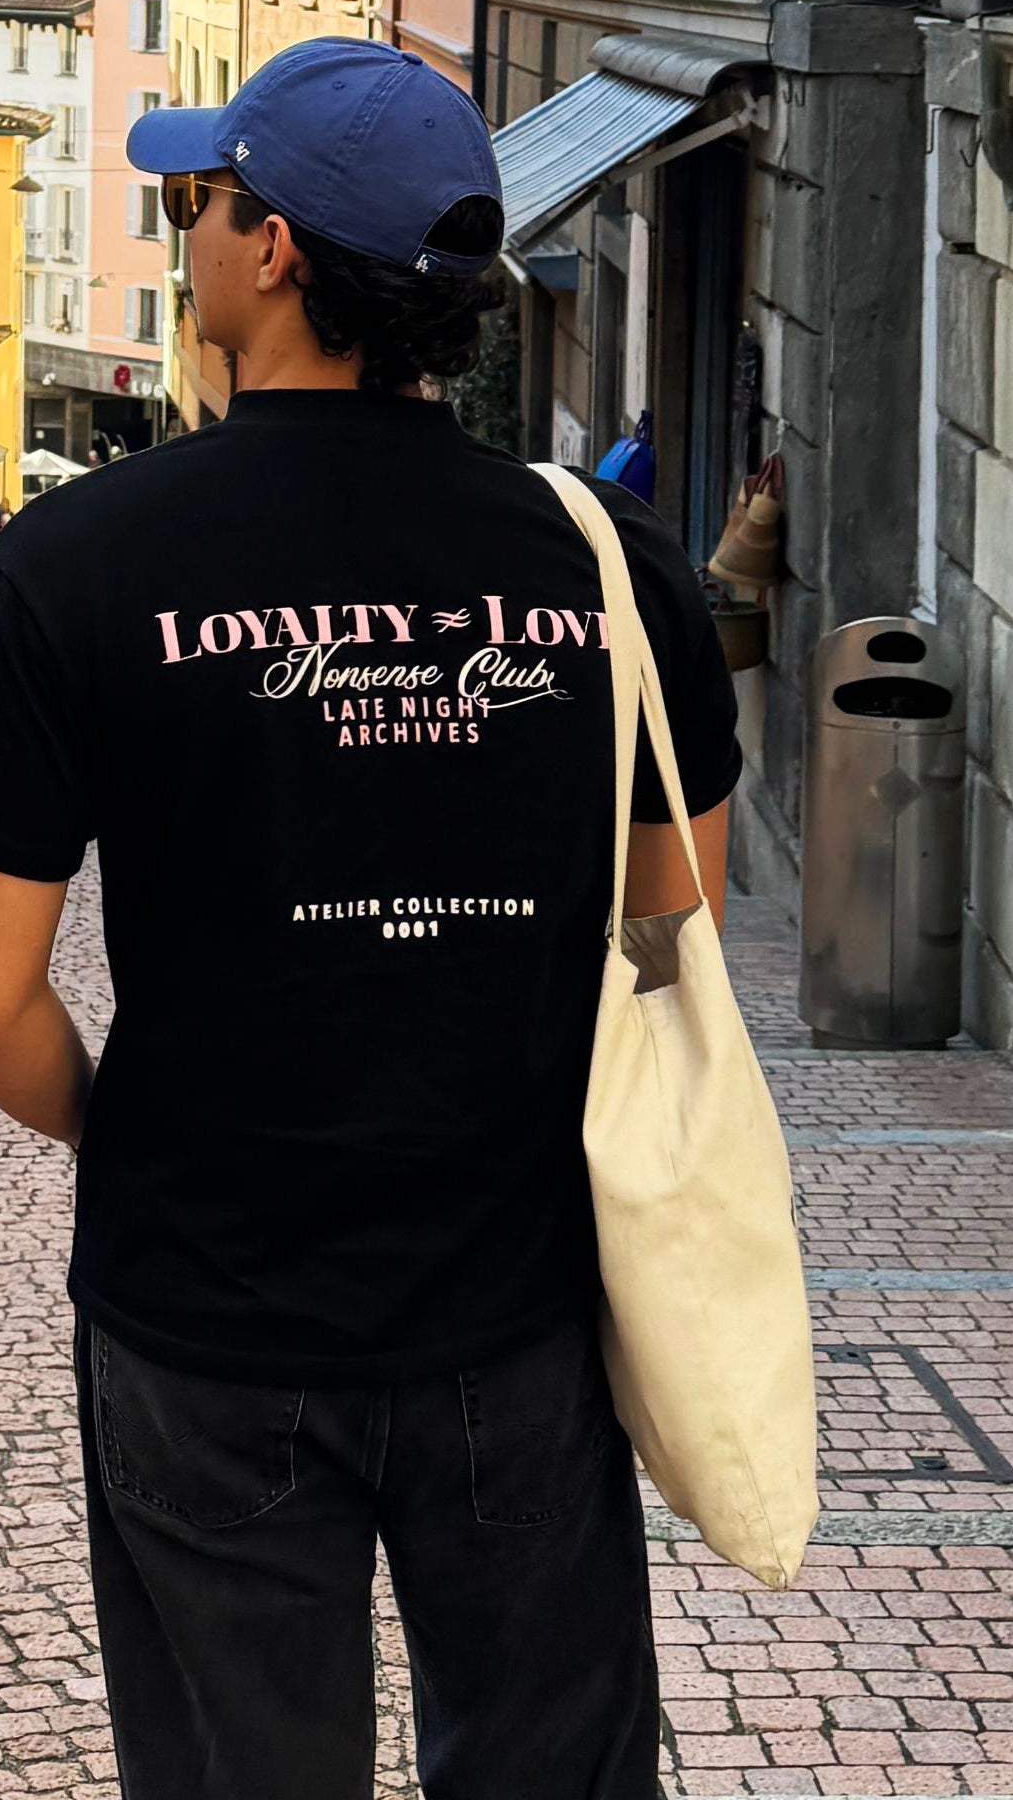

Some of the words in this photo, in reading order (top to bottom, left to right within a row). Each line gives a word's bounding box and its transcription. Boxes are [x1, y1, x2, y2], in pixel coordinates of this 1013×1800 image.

[154, 604, 419, 664] LOYALTY
[249, 634, 443, 699] Nonsense
[457, 647, 576, 709] Club
[323, 698, 386, 722] LATE
[401, 696, 490, 719] NIGHT
[339, 722, 480, 747] ARCHIVES
[293, 899, 381, 921] ATELIER
[393, 897, 535, 916] COLLECTION
[383, 920, 438, 939] 0001
